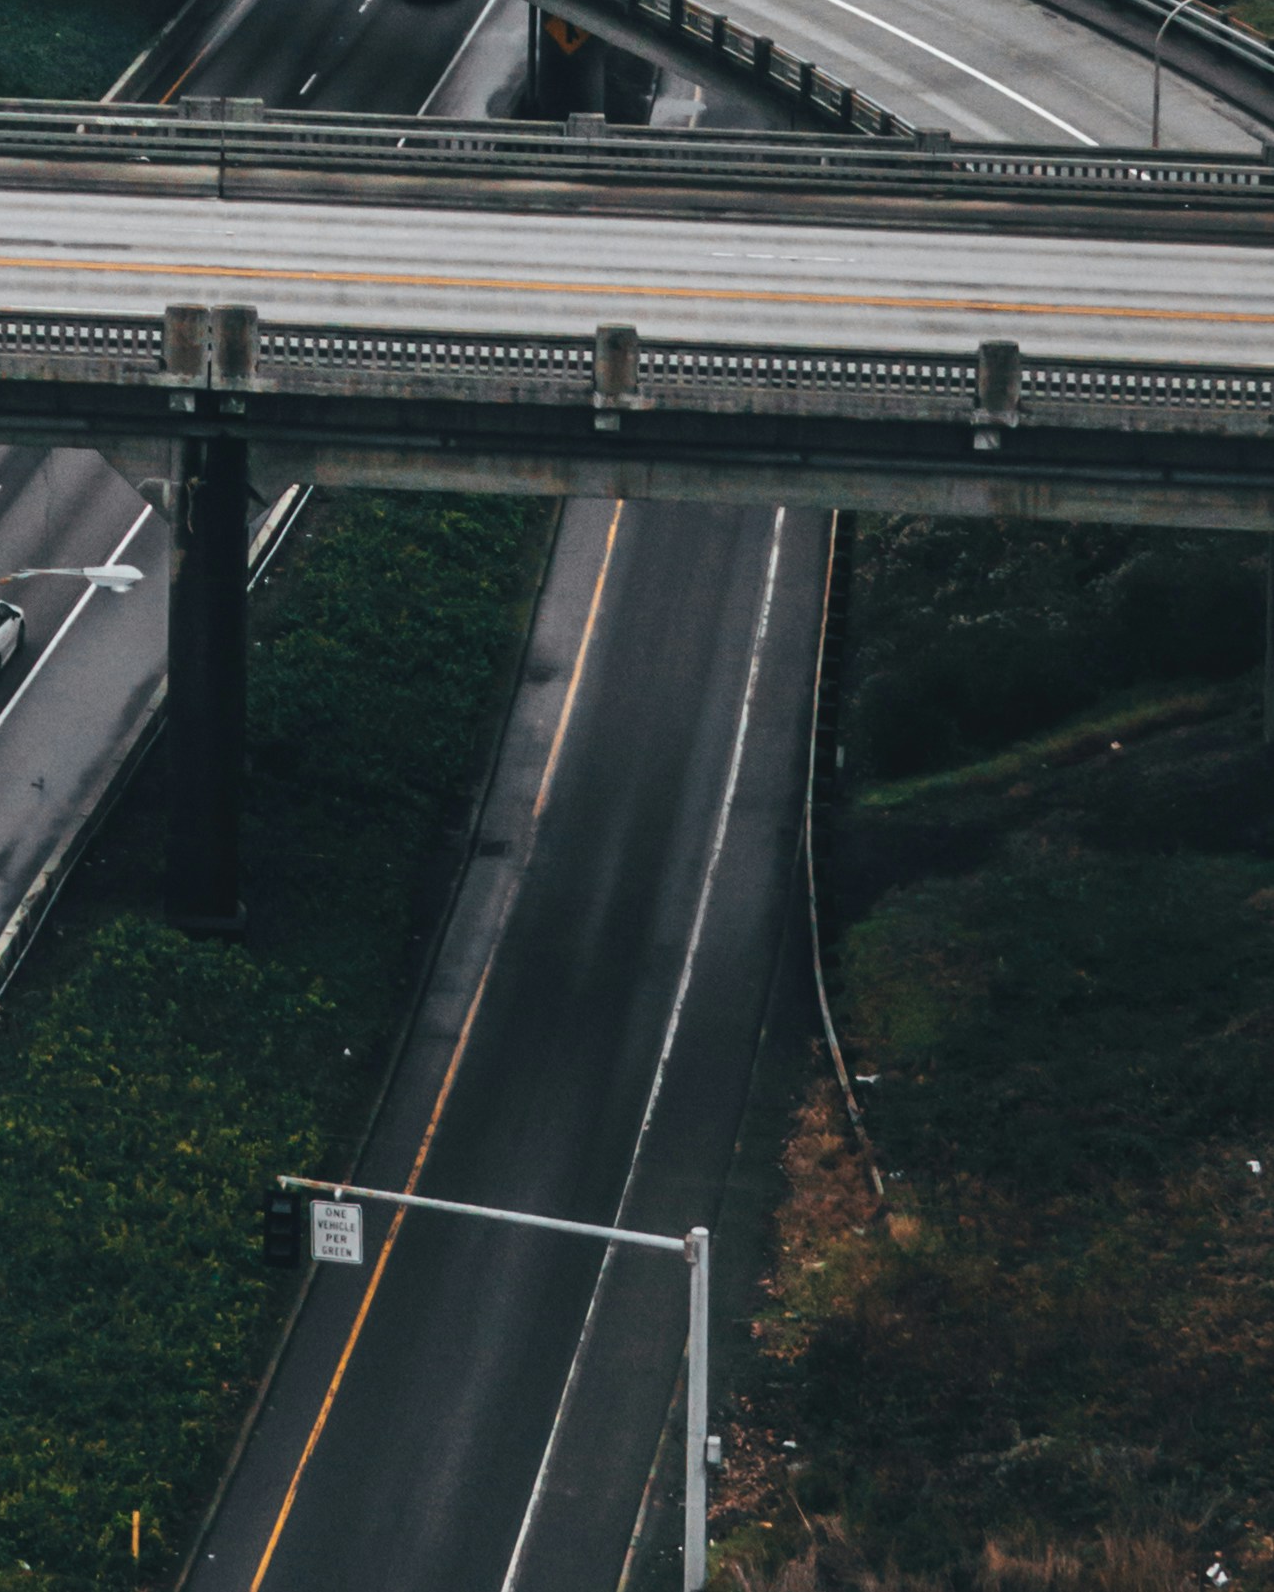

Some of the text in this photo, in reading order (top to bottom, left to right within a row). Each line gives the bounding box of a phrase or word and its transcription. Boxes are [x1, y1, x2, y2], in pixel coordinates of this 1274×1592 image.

[325, 1207, 347, 1219] ONE
[317, 1219, 355, 1233] VEHICLE
[325, 1233, 348, 1244] PER
[321, 1245, 352, 1257] GREEN
